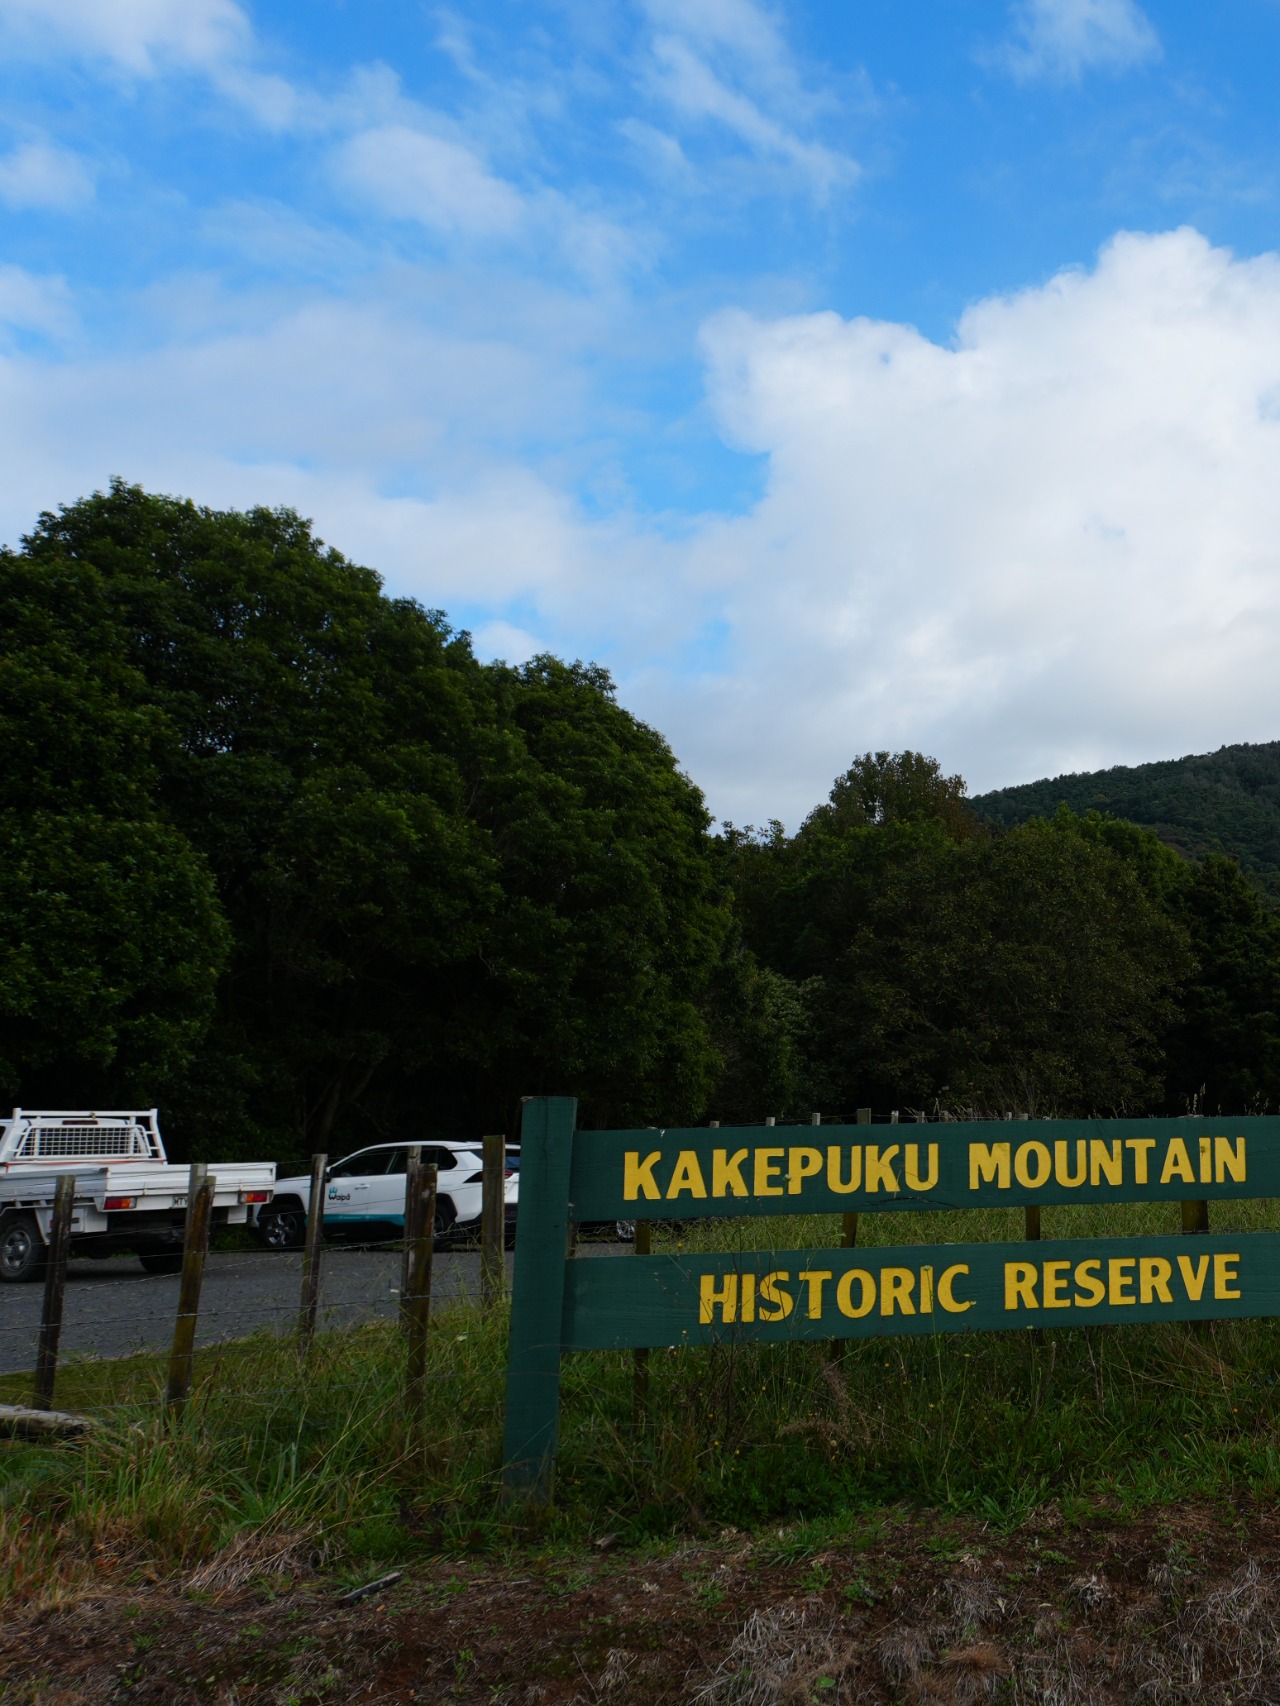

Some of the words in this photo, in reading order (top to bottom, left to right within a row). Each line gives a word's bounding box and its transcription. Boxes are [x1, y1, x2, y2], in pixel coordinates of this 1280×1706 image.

[623, 1143, 939, 1201] KAKEPUKU
[969, 1136, 1247, 1190] MOUNTAIN
[699, 1264, 976, 1324] HISTORIC
[1004, 1253, 1241, 1310] RESERVE
